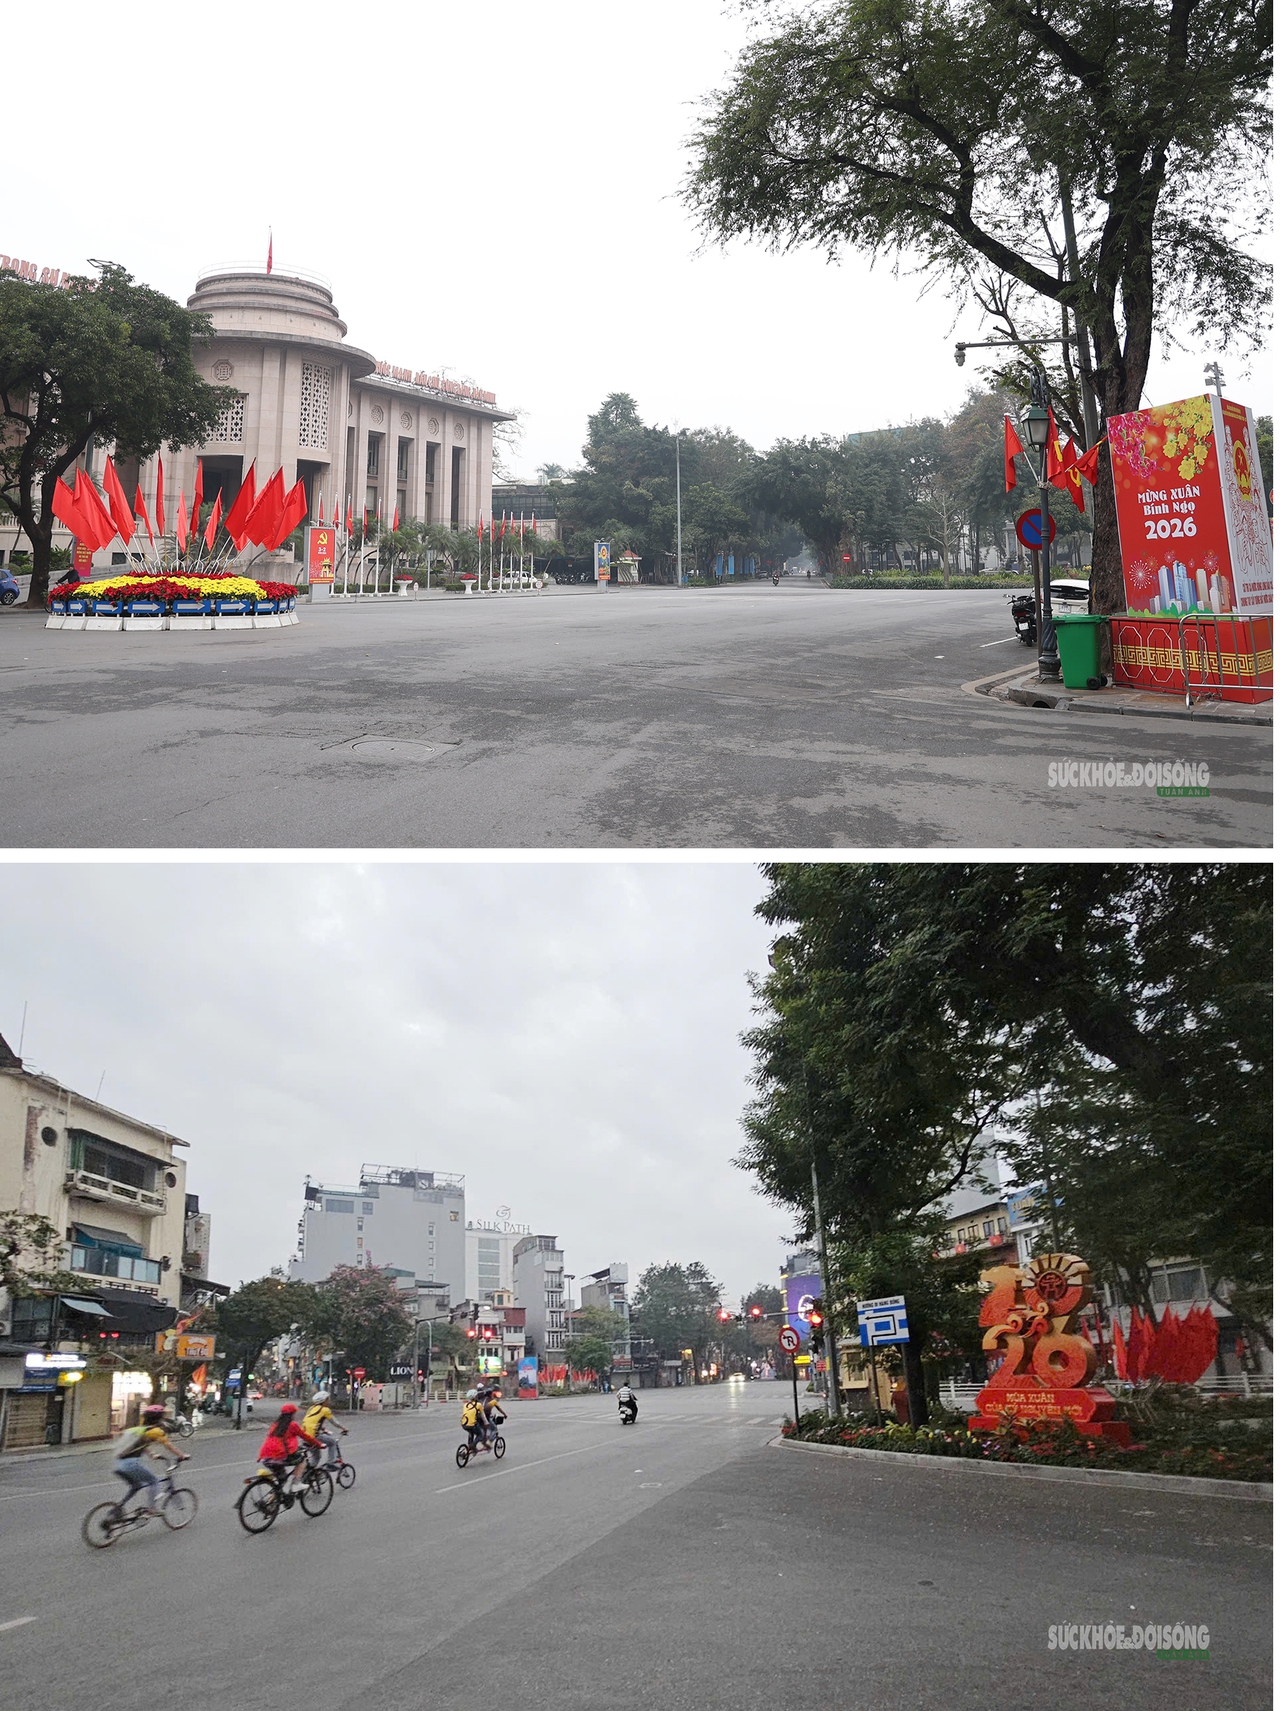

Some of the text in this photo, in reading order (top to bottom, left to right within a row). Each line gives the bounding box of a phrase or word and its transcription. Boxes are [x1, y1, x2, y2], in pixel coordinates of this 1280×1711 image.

[1137, 484, 1201, 504] MỪNG XUÂN
[1143, 501, 1196, 516] Bính Ngọ
[1144, 516, 1197, 540] 2026
[476, 1219, 531, 1236] SILK PATH
[390, 1366, 414, 1376] LION
[1028, 1392, 1055, 1403] XUÂN
